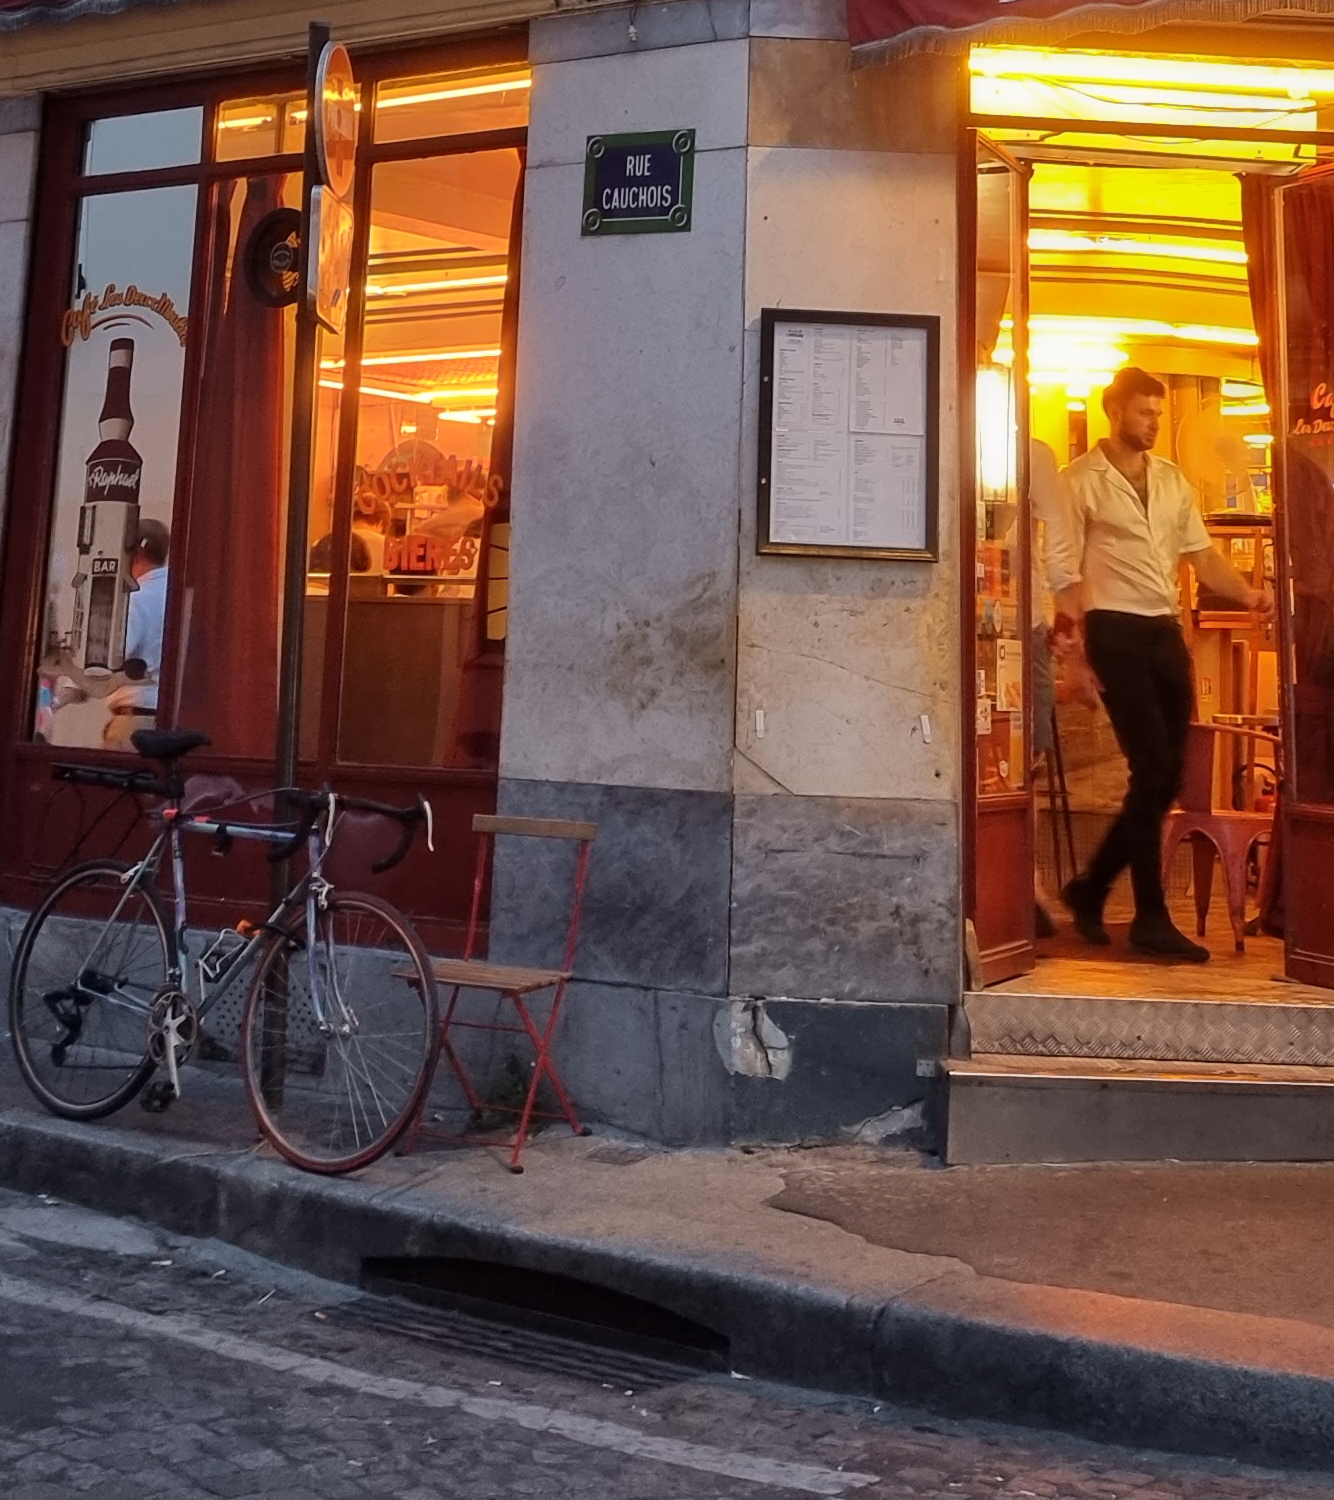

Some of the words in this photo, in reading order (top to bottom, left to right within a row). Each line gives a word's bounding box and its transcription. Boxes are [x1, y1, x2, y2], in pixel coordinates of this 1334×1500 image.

[625, 154, 652, 177] RUE
[602, 185, 672, 210] CAUCHOIS
[93, 560, 117, 574] BAR
